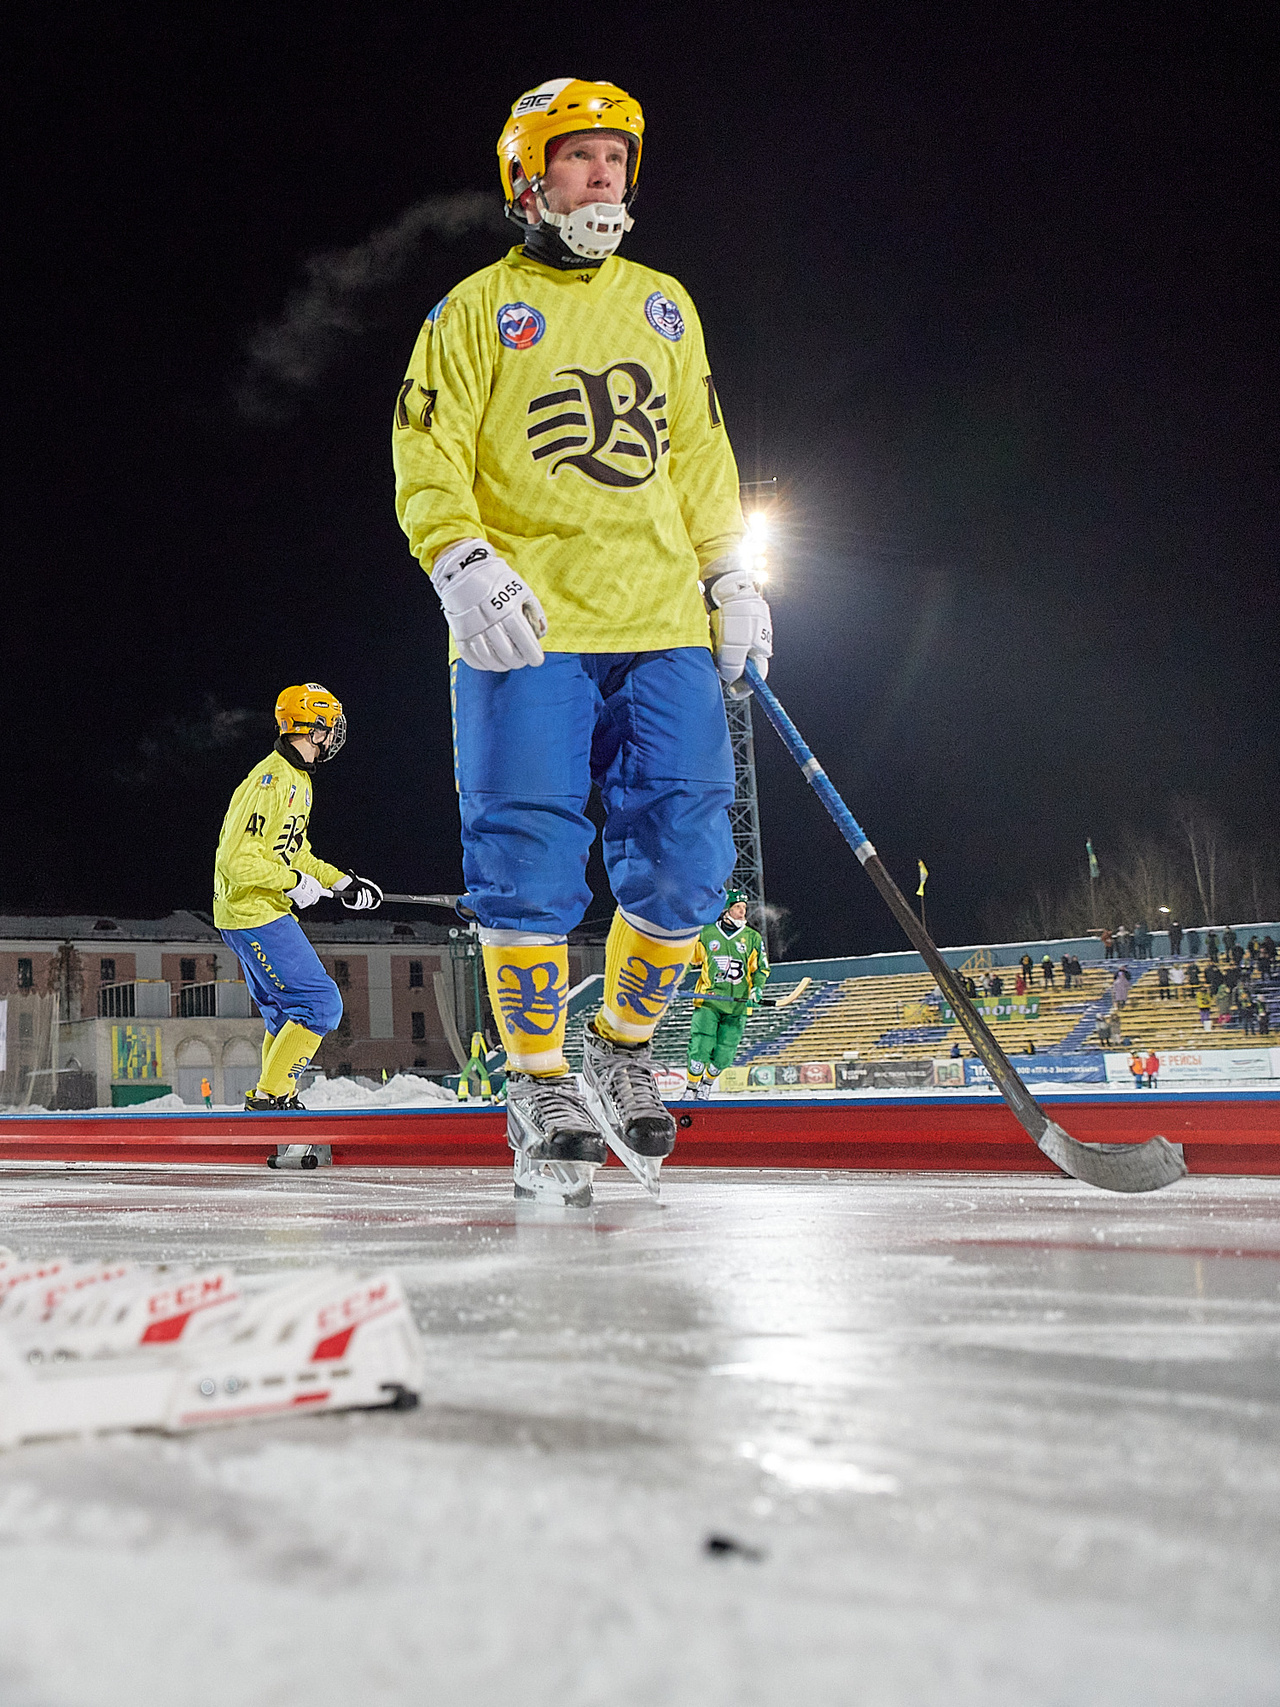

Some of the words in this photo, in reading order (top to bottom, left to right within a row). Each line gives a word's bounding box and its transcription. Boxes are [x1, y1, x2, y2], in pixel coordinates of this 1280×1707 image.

[490, 580, 523, 610] 5055
[245, 812, 266, 837] 47
[148, 1276, 223, 1314] CCM
[317, 1282, 388, 1329] CCM
